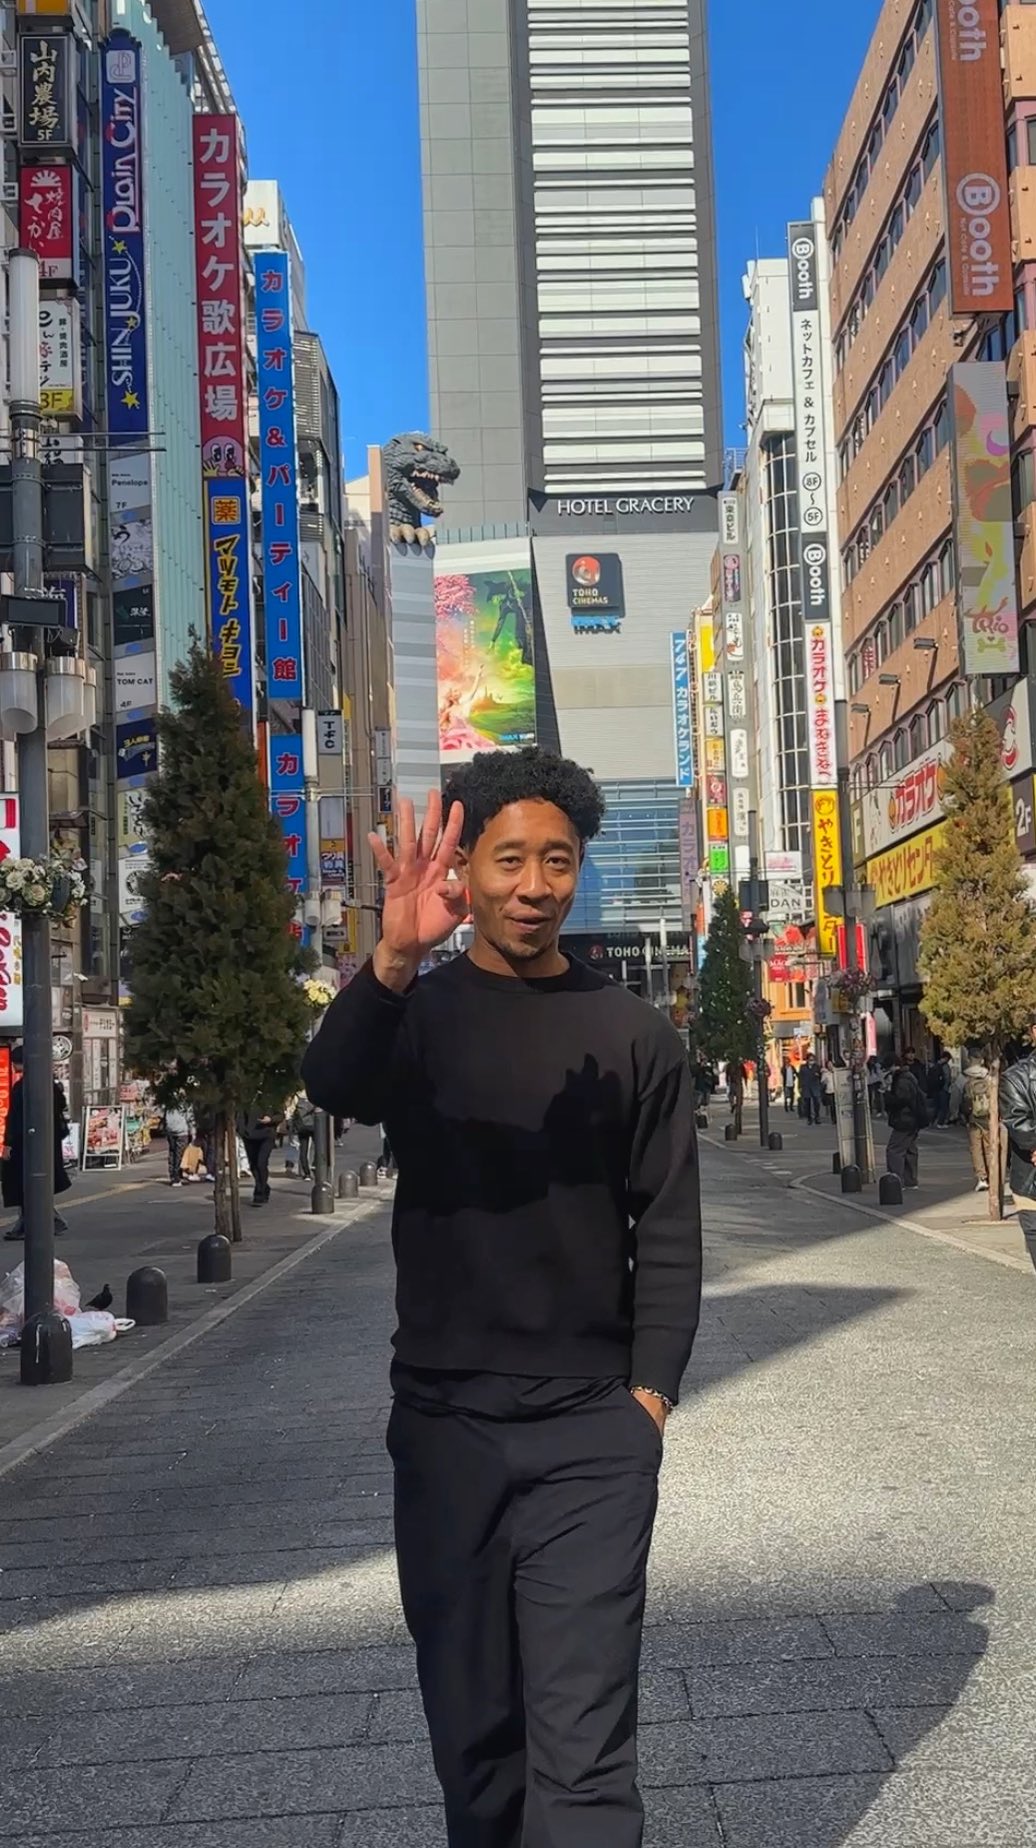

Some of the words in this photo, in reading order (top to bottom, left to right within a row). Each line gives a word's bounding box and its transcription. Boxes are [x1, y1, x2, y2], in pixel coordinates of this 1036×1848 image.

[957, 0, 987, 61] oth
[29, 40, 60, 129] 山内農場
[37, 130, 53, 141] 5F
[956, 173, 1000, 296] Booth
[200, 127, 239, 421] カラオケ歌広場
[792, 237, 815, 299] Booth
[109, 258, 141, 386] SHINJUKU
[804, 414, 817, 463] カプセル
[112, 479, 148, 487] Penelope
[557, 499, 612, 515] HOTEL
[616, 496, 694, 513] GRACERY
[215, 499, 238, 523] 薬
[572, 588, 598, 597] TOHO
[572, 597, 608, 605] CINEMAS
[804, 543, 826, 606] Booth
[213, 534, 242, 678] マツモトキヨシ
[117, 678, 135, 686] TOM
[137, 677, 153, 685] CAT
[811, 639, 828, 693] カラオケ
[814, 708, 832, 777] まねきねこ
[895, 761, 937, 825] カラオケ
[1016, 798, 1032, 837] 2F
[771, 898, 801, 908] DAN
[818, 818, 837, 951] やきとりター
[606, 946, 640, 958] TOHO
